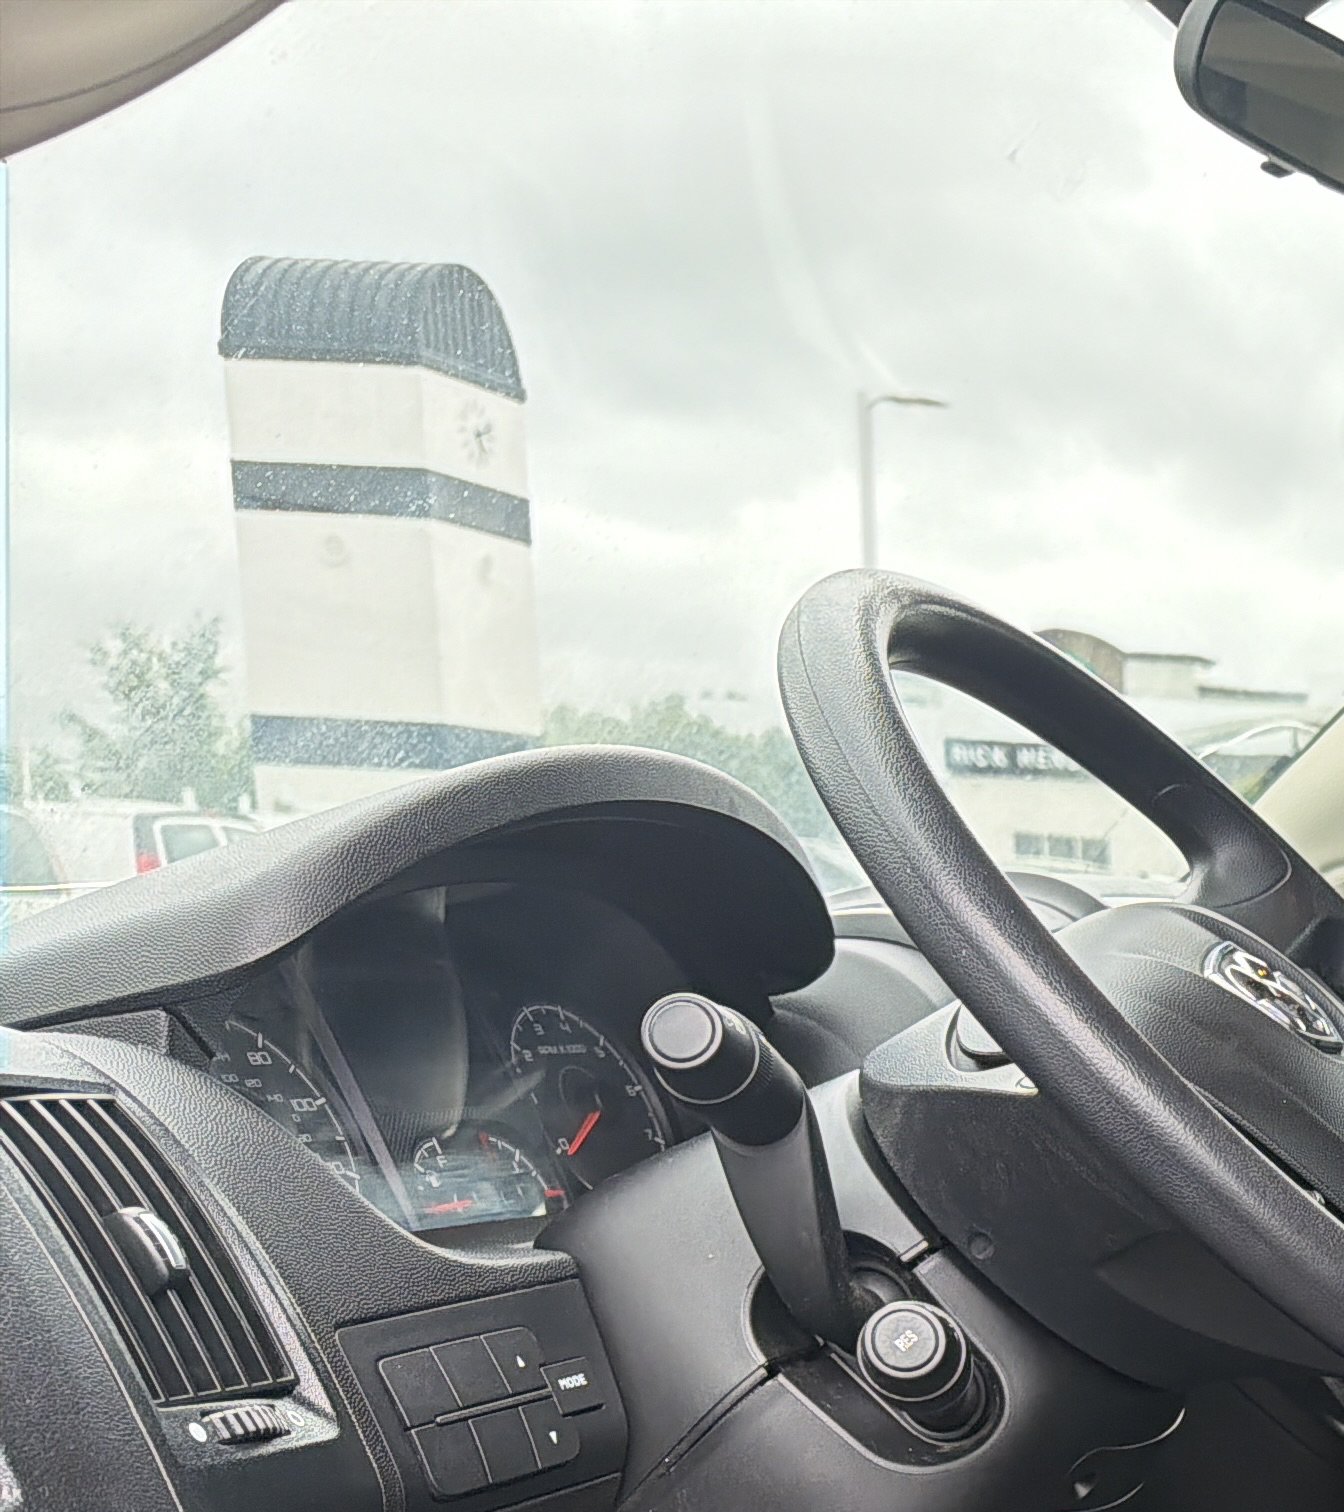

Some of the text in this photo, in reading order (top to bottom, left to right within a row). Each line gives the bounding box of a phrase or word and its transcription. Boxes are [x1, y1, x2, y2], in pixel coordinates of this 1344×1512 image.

[533, 1023, 545, 1036] 3
[559, 1022, 572, 1034] 4
[246, 1051, 272, 1065] 80
[522, 1050, 534, 1062] 2
[625, 1085, 637, 1097] 6
[558, 1138, 570, 1151] 0
[894, 1329, 919, 1352] RES
[557, 1372, 588, 1391] MODE
